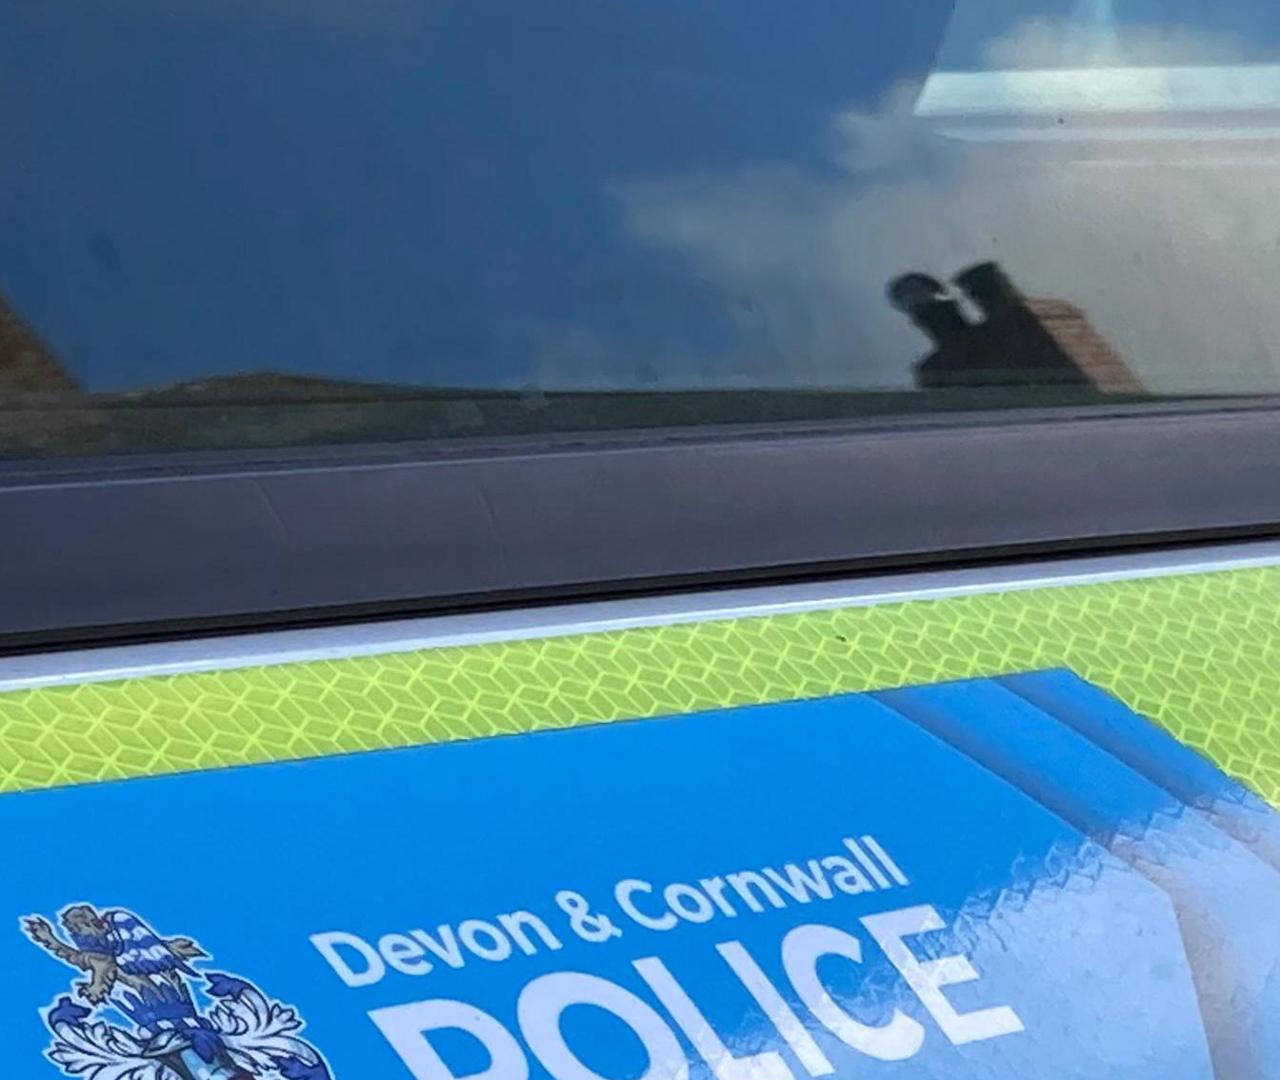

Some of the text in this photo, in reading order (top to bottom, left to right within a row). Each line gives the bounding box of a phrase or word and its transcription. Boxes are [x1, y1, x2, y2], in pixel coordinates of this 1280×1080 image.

[309, 835, 910, 986] Devon & Cornwall
